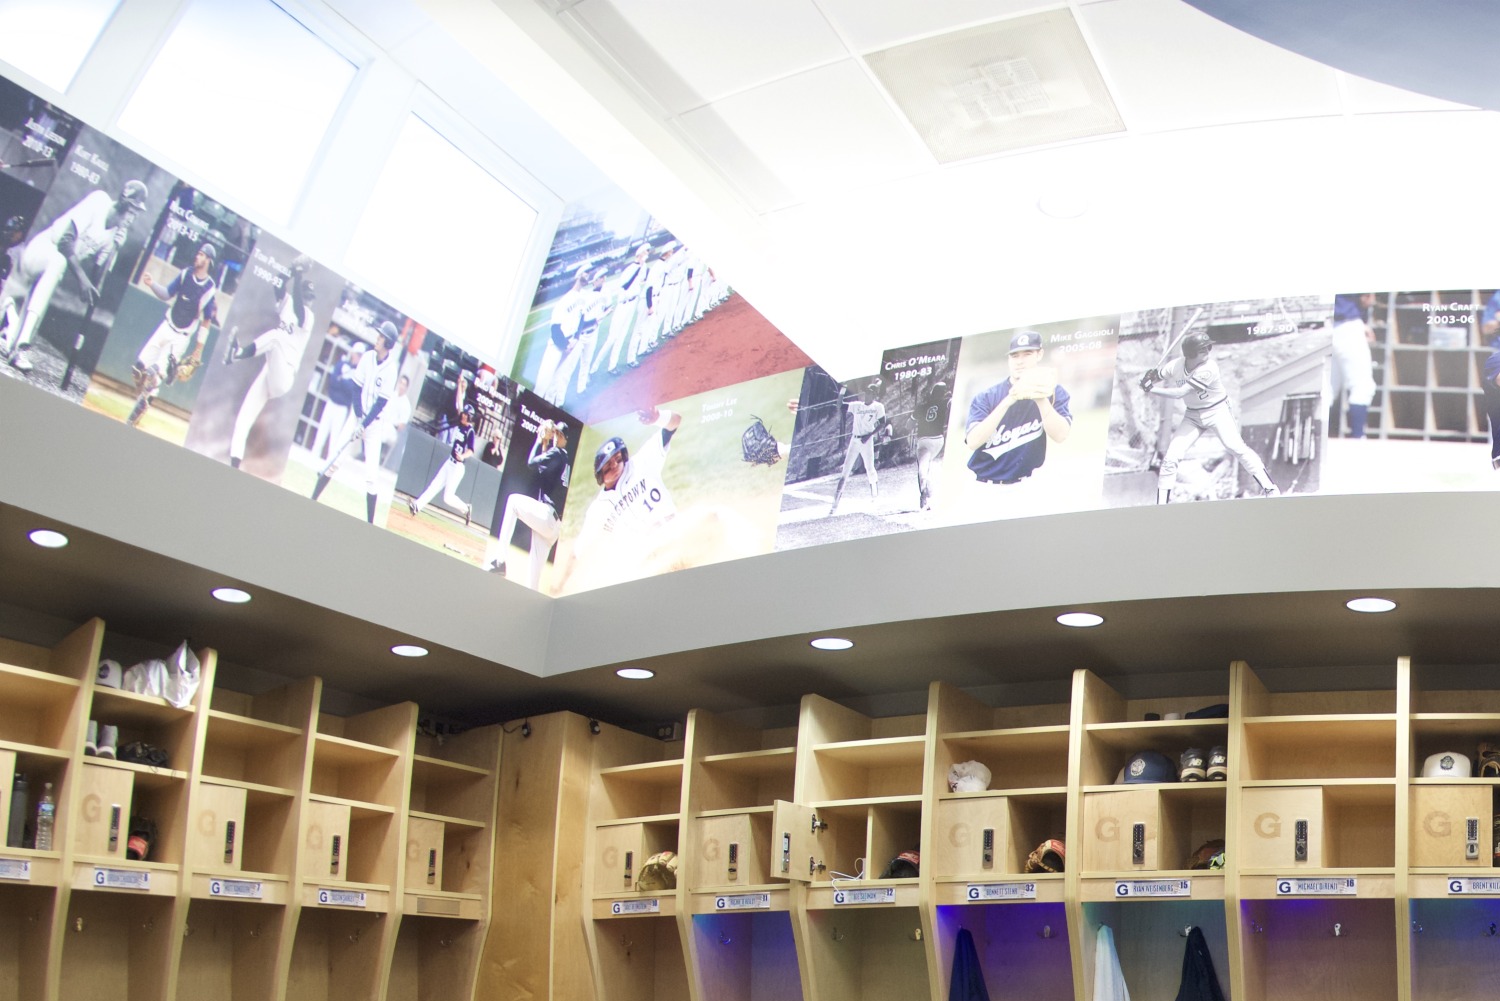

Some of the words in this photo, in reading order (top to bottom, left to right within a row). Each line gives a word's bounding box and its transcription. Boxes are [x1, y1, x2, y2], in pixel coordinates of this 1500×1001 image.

[253, 265, 284, 288] 1990-93
[1422, 303, 1447, 312] RYAN
[1450, 302, 1480, 312] CRAFT
[1426, 315, 1475, 325] 2003-06
[1247, 325, 1292, 335] 1987-90
[1050, 332, 1072, 343] MIKE
[1059, 341, 1103, 353] 2005-08
[885, 361, 907, 371] CHRIS
[908, 354, 946, 366] O'MEARA
[894, 367, 933, 381] 1980-83
[643, 487, 662, 512] 10
[1094, 816, 1120, 842] G
[1253, 812, 1281, 839] G
[1424, 811, 1452, 838] G
[96, 871, 105, 885] G
[211, 882, 220, 894] G
[969, 888, 979, 898] G
[1025, 884, 1034, 892] 32
[1117, 884, 1128, 895] G
[1180, 881, 1187, 889] 15
[1279, 882, 1291, 893] G
[1450, 881, 1462, 892] G
[320, 892, 328, 903] G
[717, 898, 725, 908] G
[613, 904, 621, 914] G
